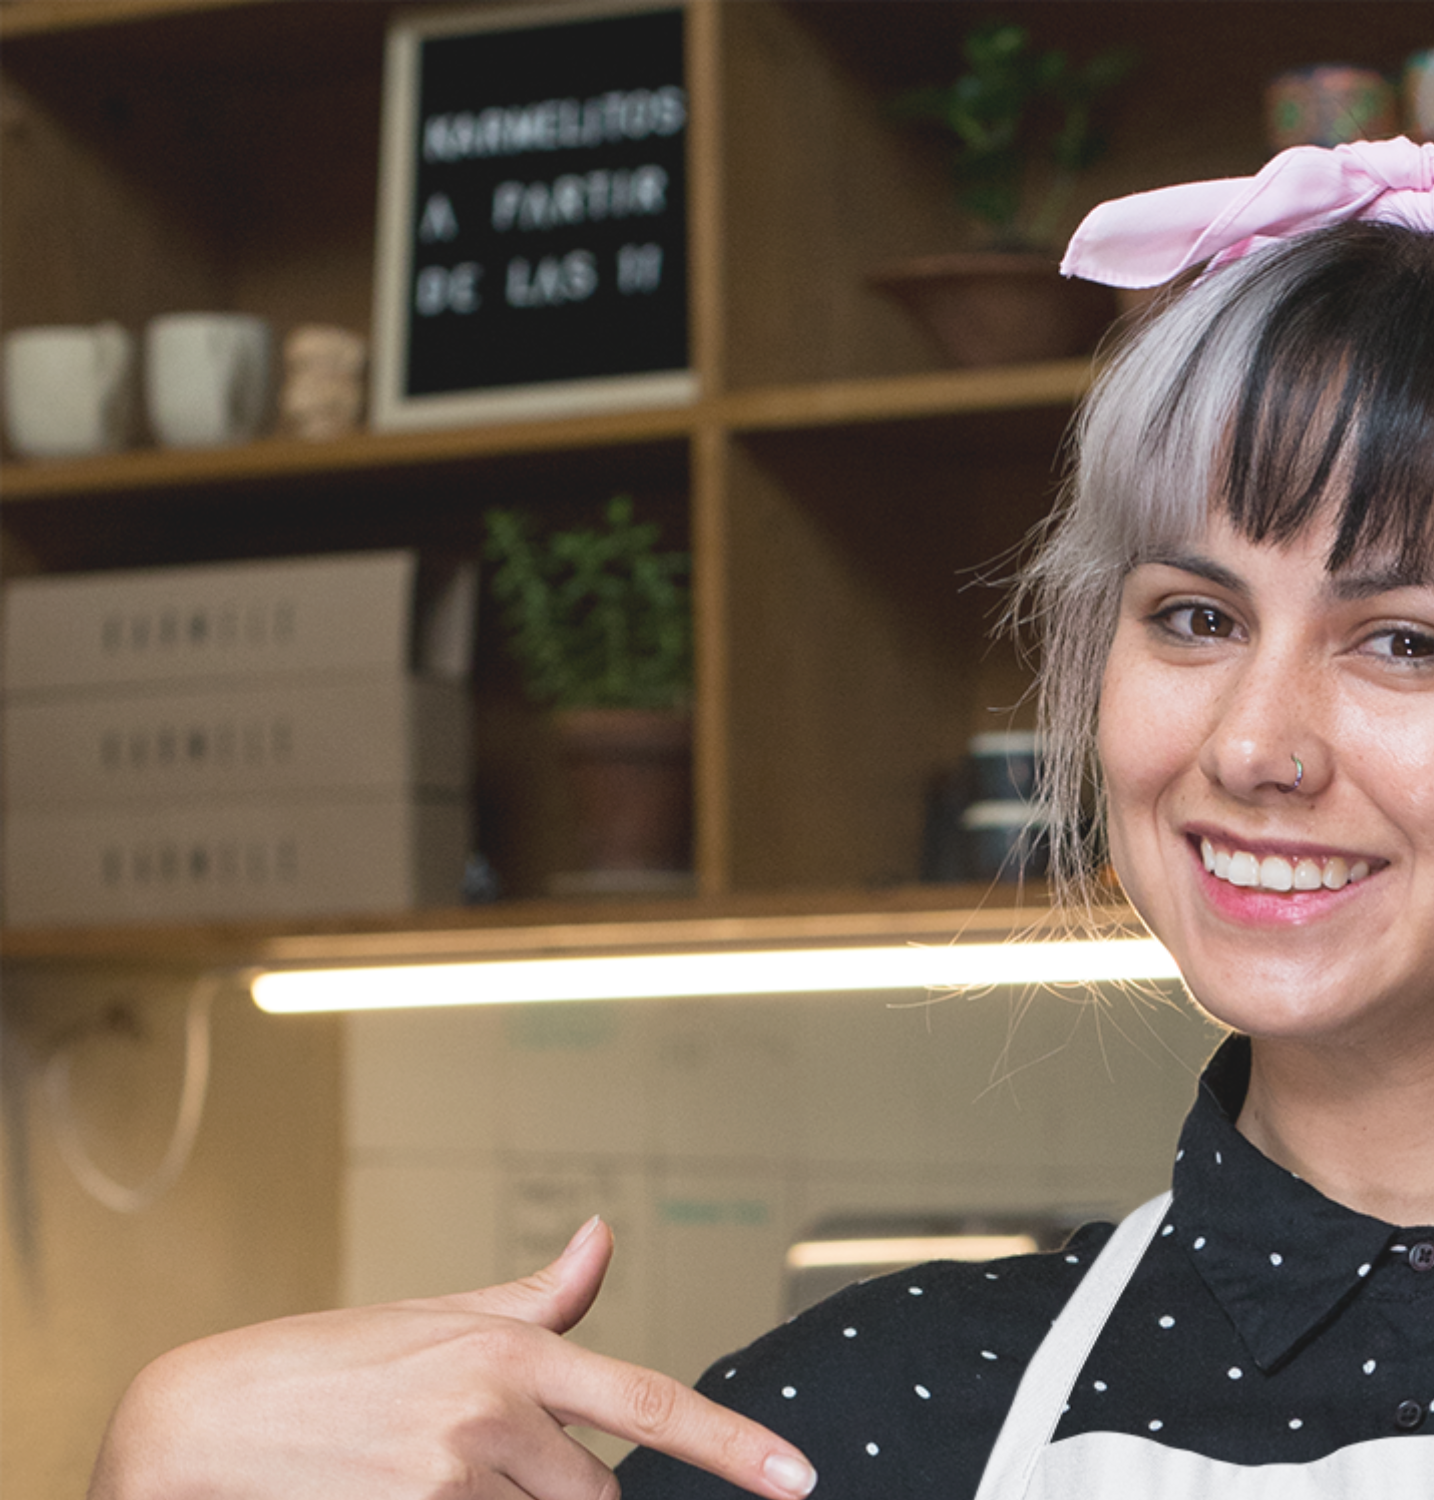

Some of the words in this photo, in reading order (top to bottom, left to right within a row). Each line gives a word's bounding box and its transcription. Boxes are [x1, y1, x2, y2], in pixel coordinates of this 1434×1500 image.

[423, 85, 686, 162] KARMELITOS
[420, 192, 459, 243] A
[492, 164, 668, 232] PARTIR
[416, 263, 483, 316] DE
[506, 248, 598, 308] LAS
